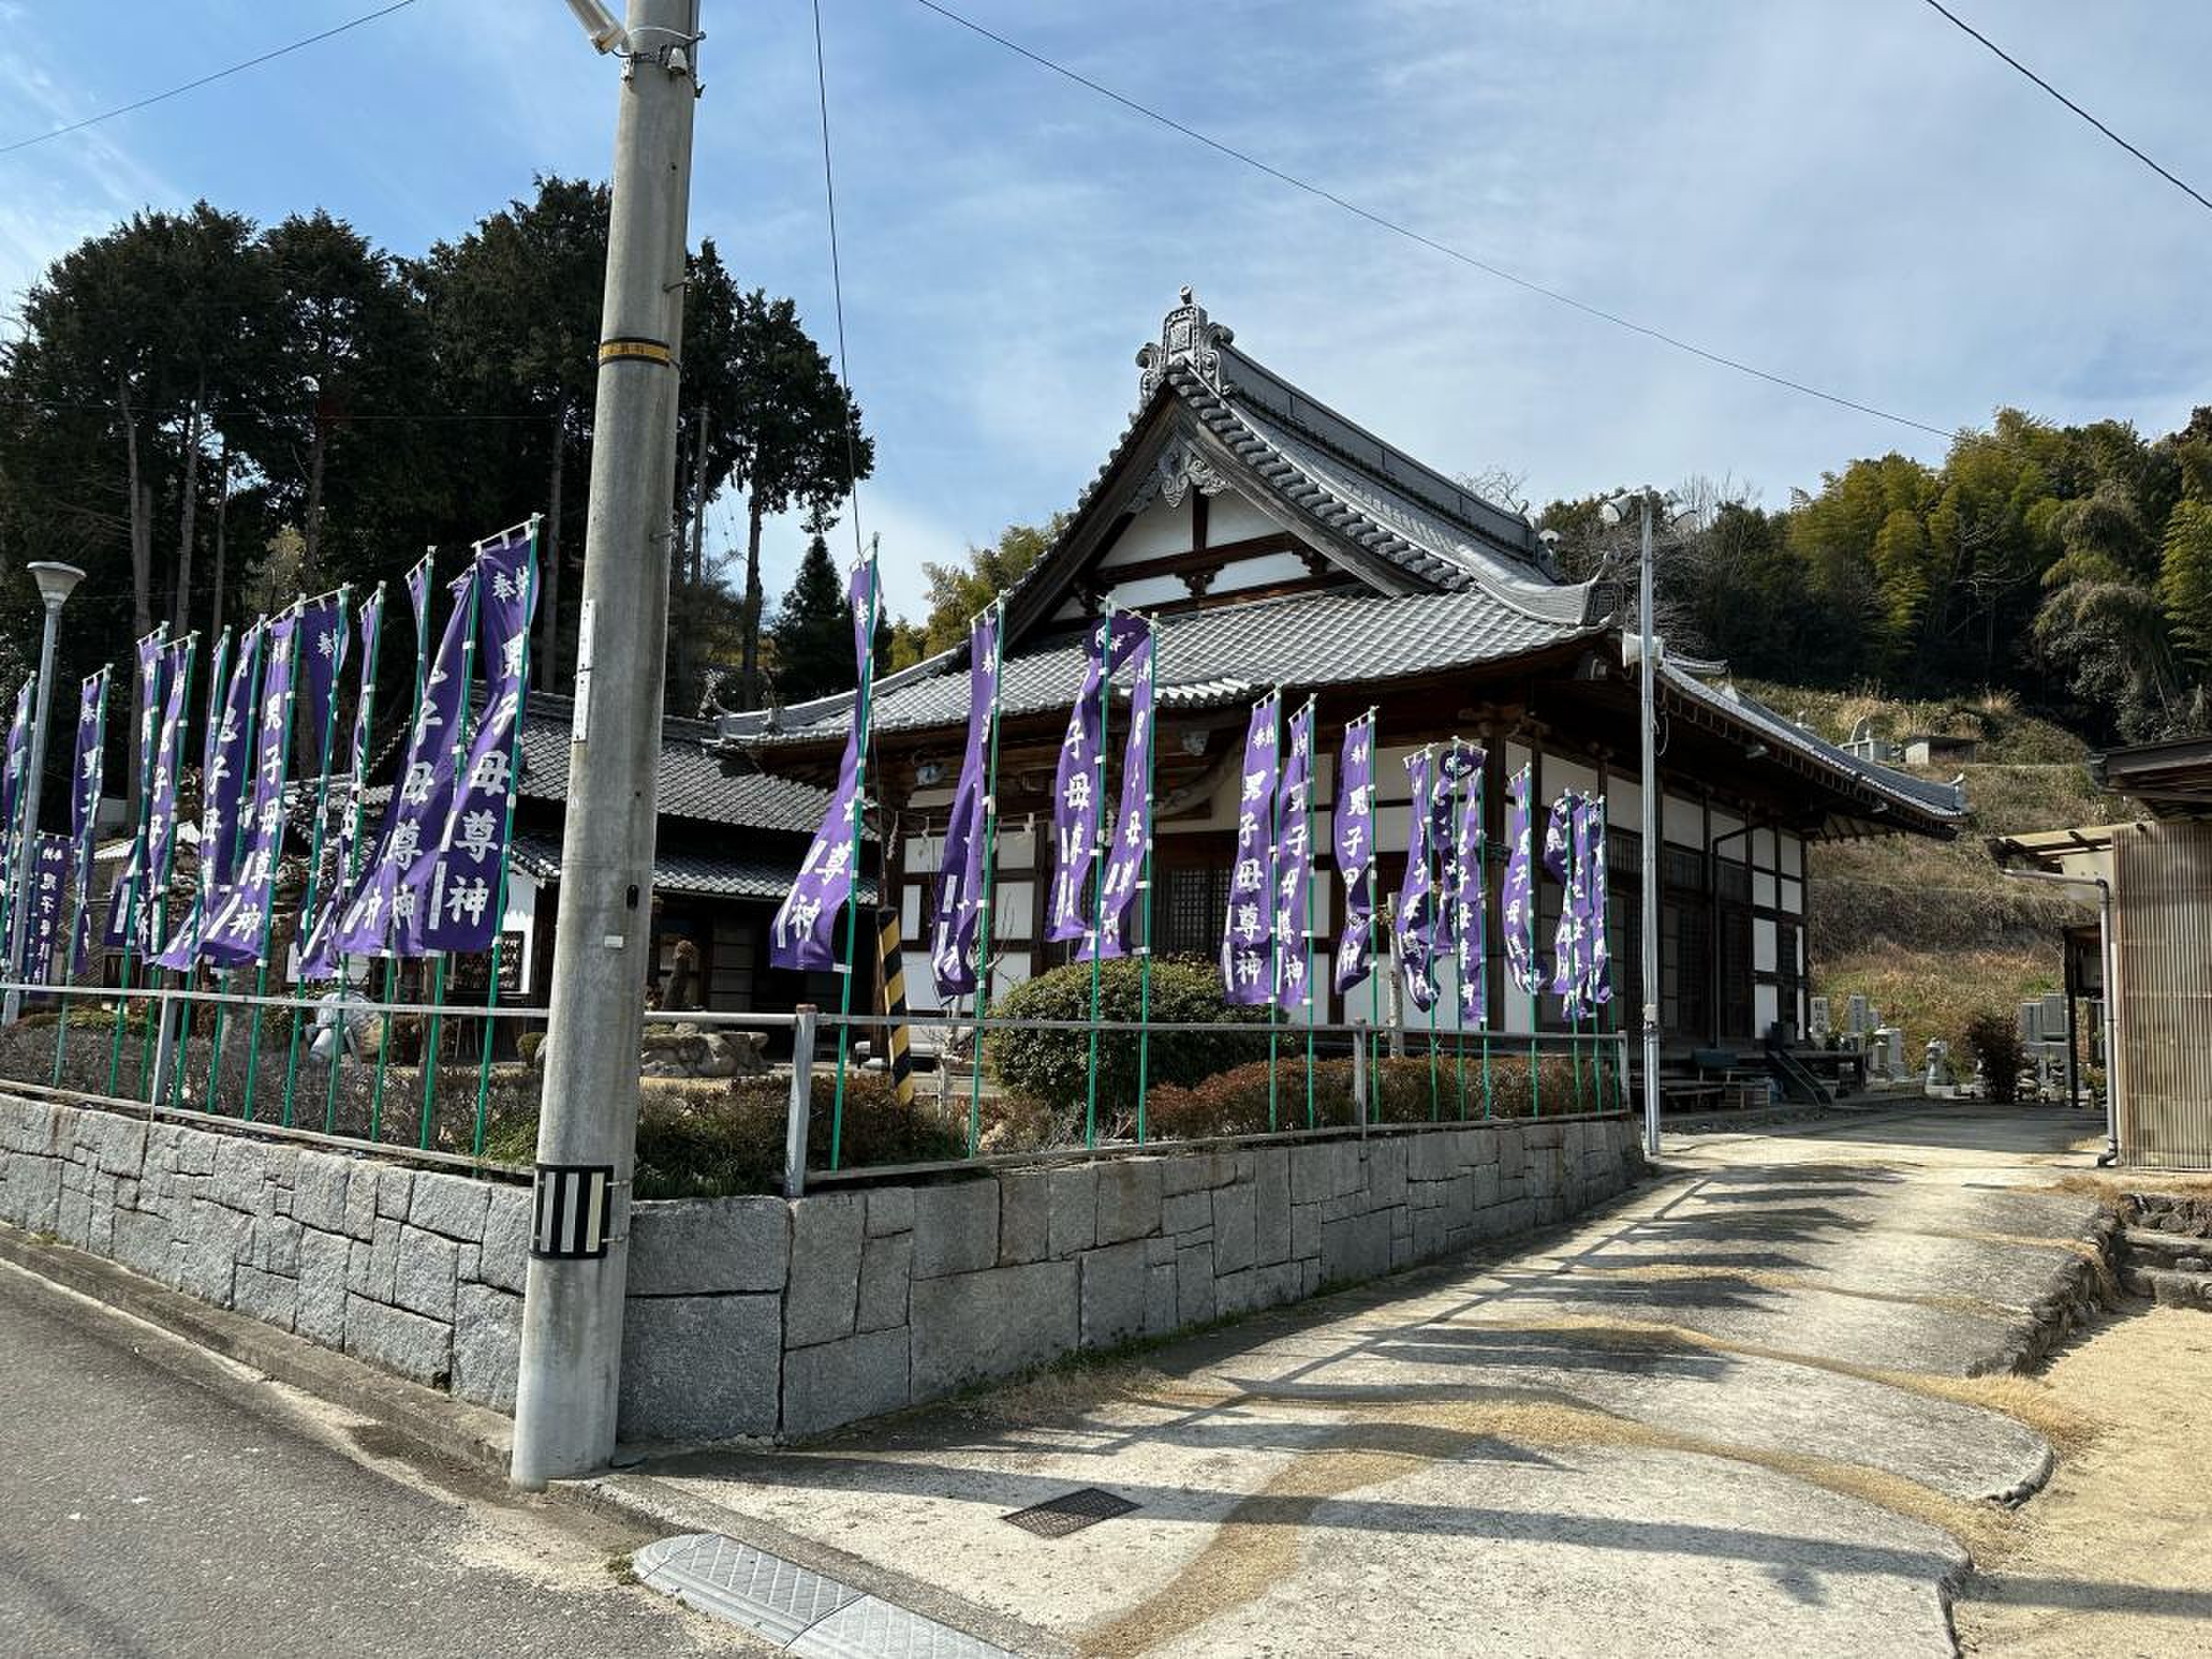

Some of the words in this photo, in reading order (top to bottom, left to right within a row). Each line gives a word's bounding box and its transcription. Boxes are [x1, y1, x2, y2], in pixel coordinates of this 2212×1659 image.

[1234, 770, 1267, 985] 鬼子母尊神
